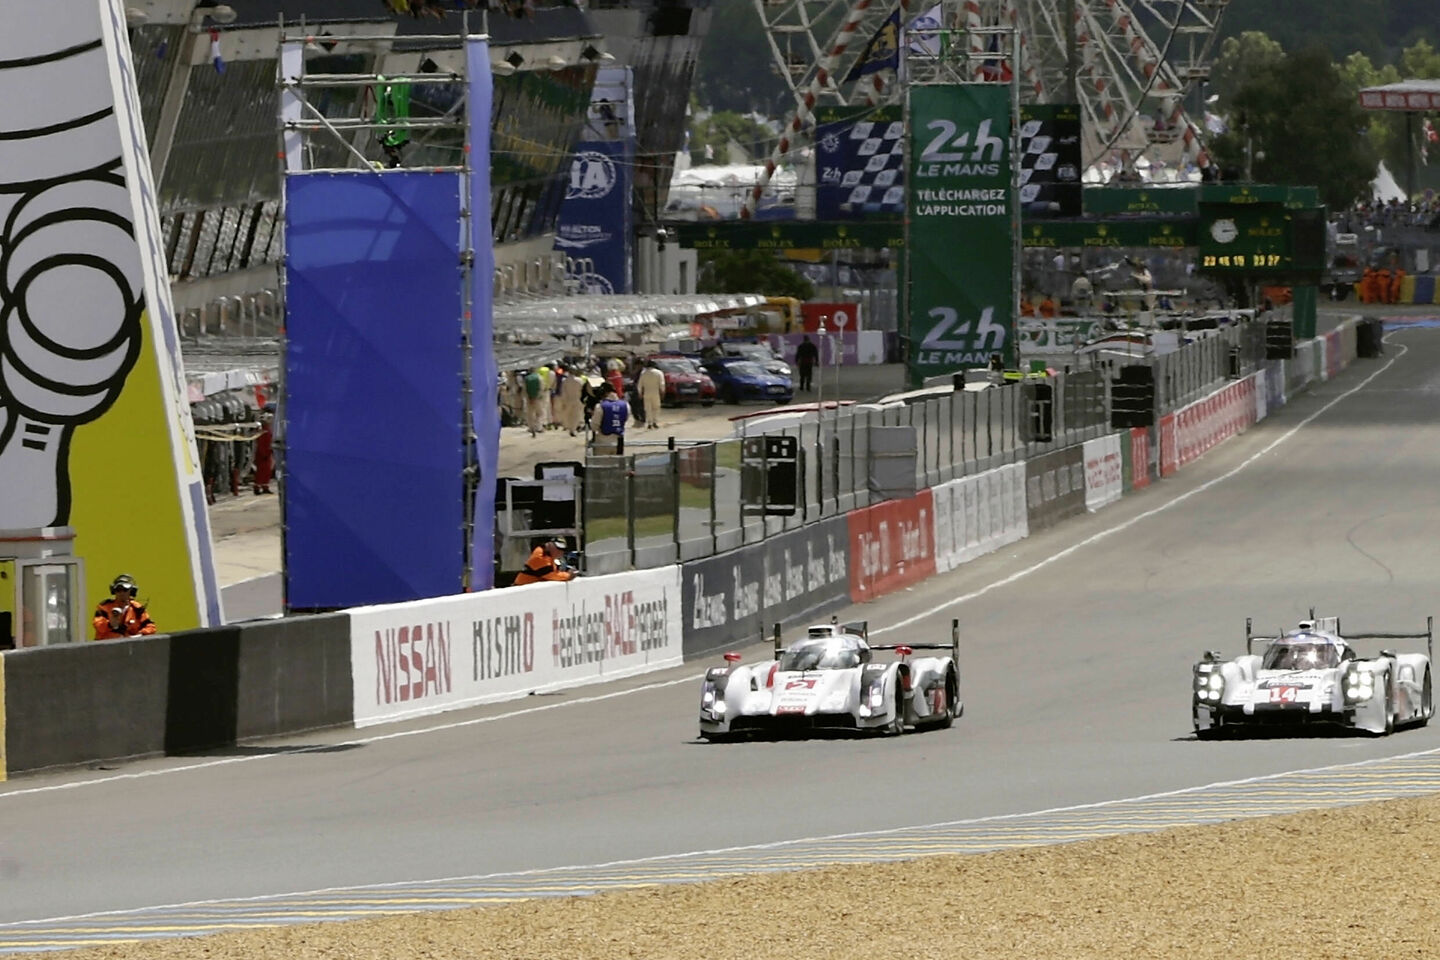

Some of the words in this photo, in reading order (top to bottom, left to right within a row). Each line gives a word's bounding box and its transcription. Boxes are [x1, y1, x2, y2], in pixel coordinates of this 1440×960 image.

[919, 118, 1005, 162] 24h
[571, 160, 609, 189] IA
[916, 164, 941, 177] LE
[943, 164, 1000, 177] MANS
[916, 187, 1006, 202] TÉLÉCHARGEZ
[916, 203, 1006, 216] L'APPLICATION
[919, 306, 1006, 350] 24h
[917, 351, 941, 364] LE
[374, 620, 453, 706] NISSAN
[1270, 687, 1298, 702] 14
